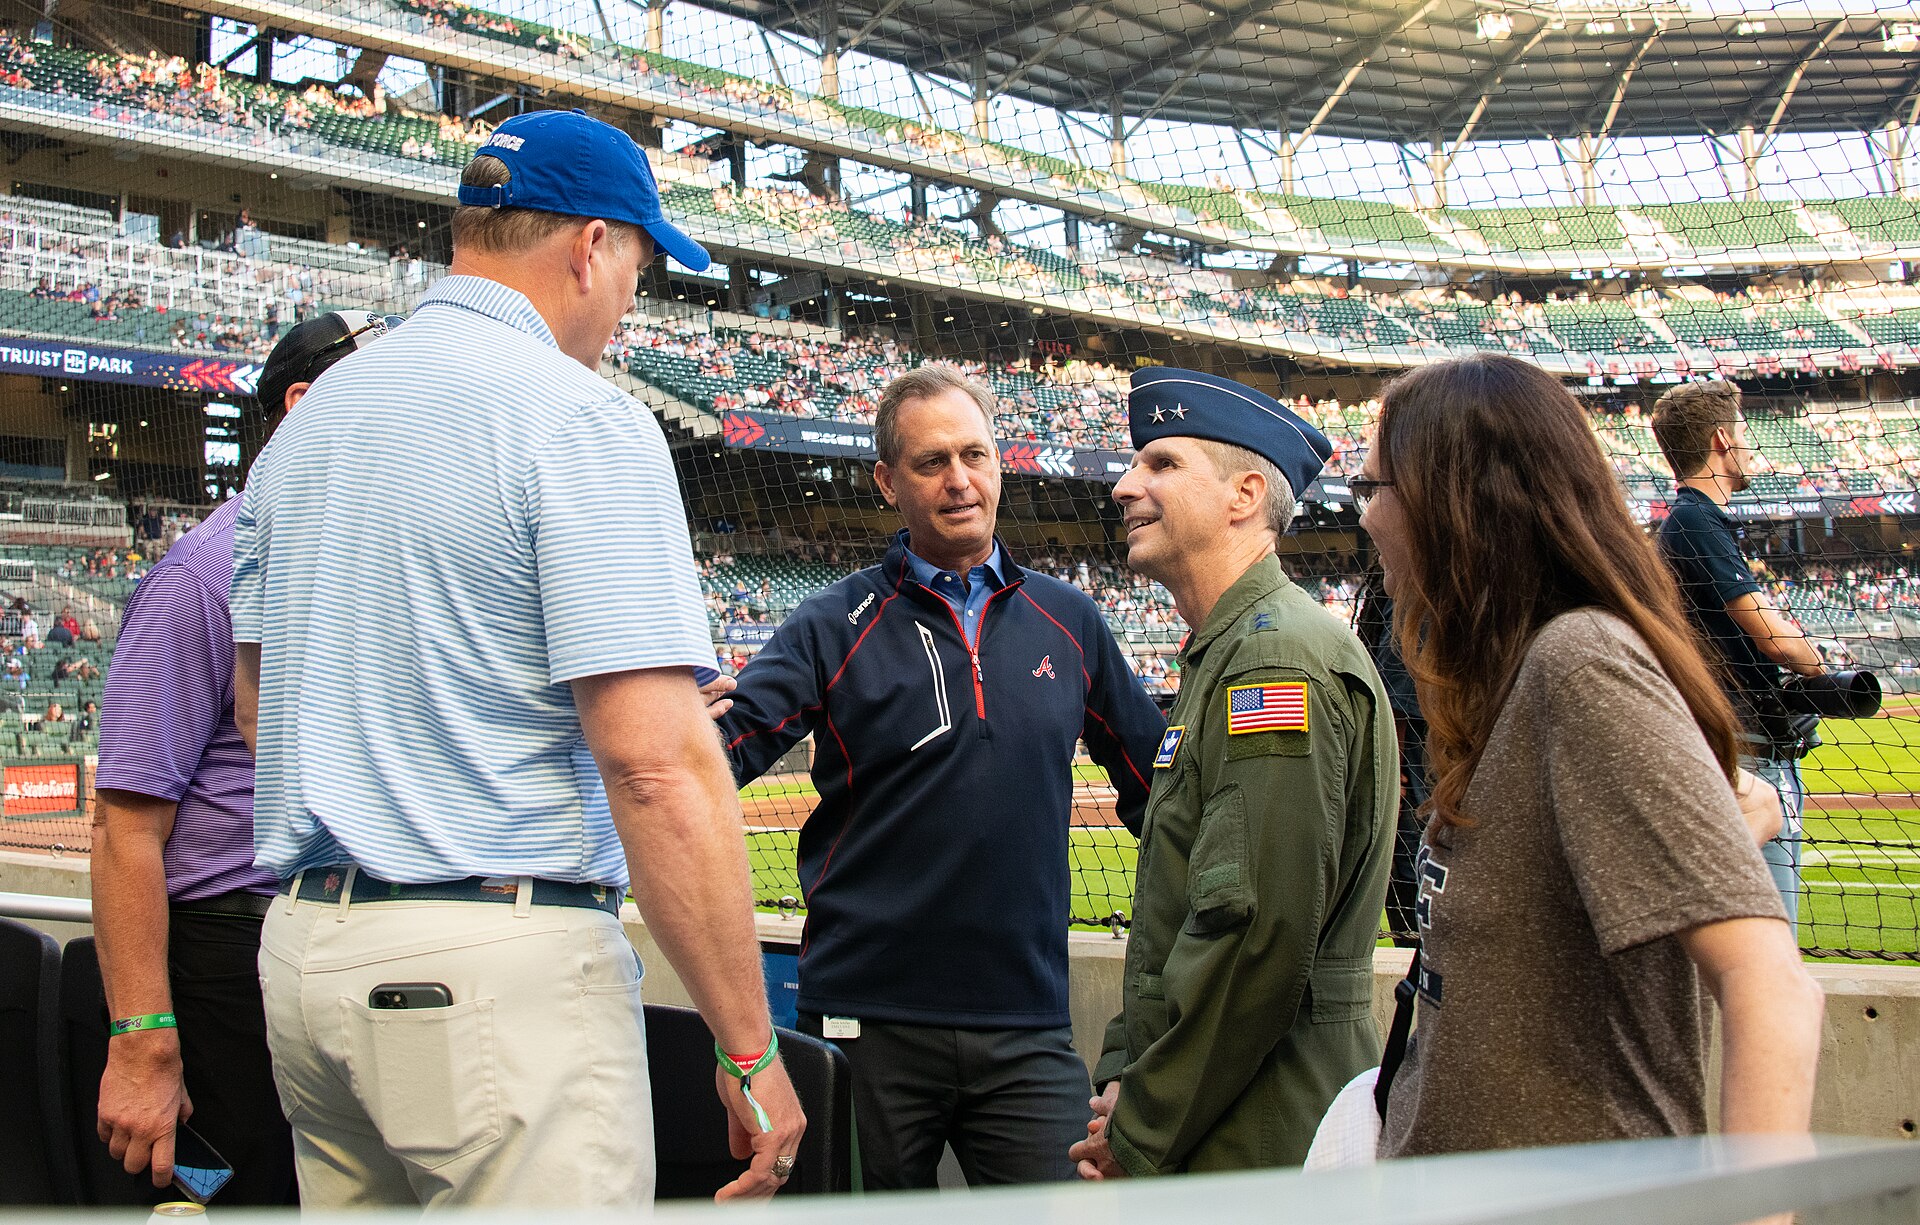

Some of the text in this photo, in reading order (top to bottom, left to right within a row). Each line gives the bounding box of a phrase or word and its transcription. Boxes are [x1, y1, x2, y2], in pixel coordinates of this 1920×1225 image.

[488, 133, 526, 152] FORCE
[0, 346, 134, 374] TRUIST PARK
[801, 430, 871, 448] WELCOME TO
[1742, 503, 1778, 515] TRUIST
[1793, 501, 1821, 513] PARK
[1032, 655, 1056, 680] A
